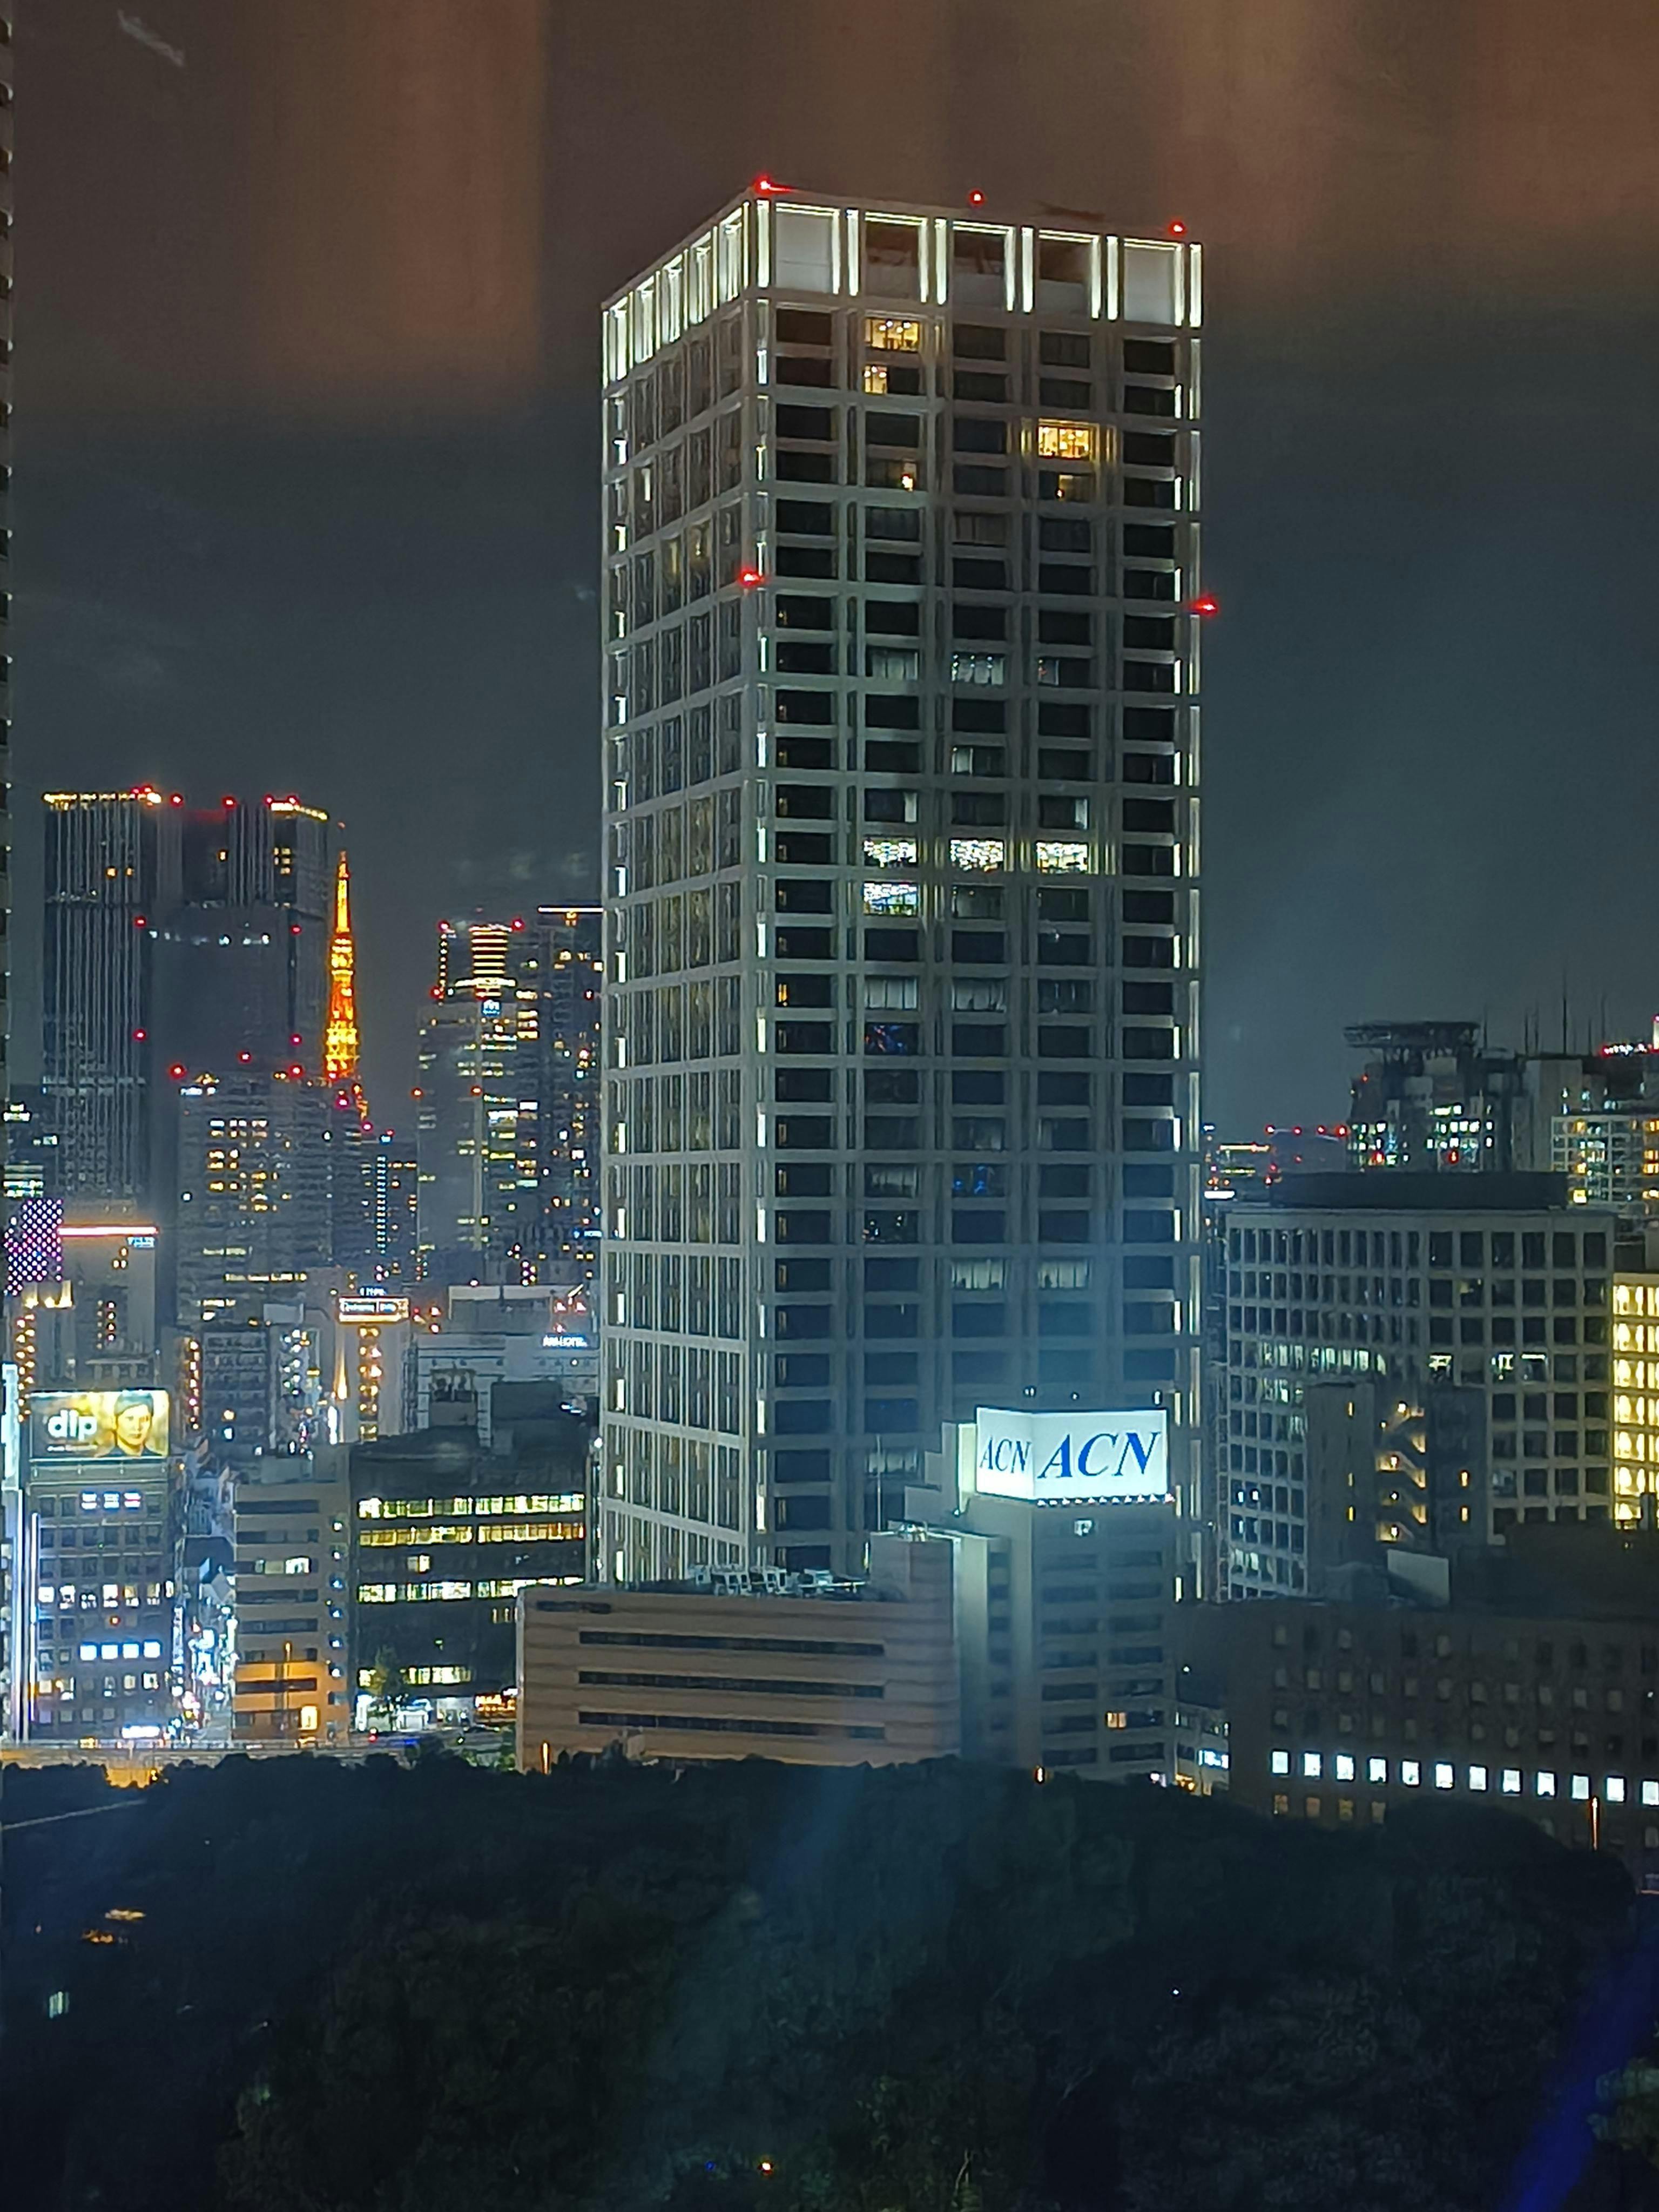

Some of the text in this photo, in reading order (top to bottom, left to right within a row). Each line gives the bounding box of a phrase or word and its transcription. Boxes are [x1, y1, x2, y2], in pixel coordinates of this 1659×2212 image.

[48, 1409, 98, 1441] dip
[979, 1434, 1032, 1473] ACN
[1037, 1431, 1162, 1479] ACN
